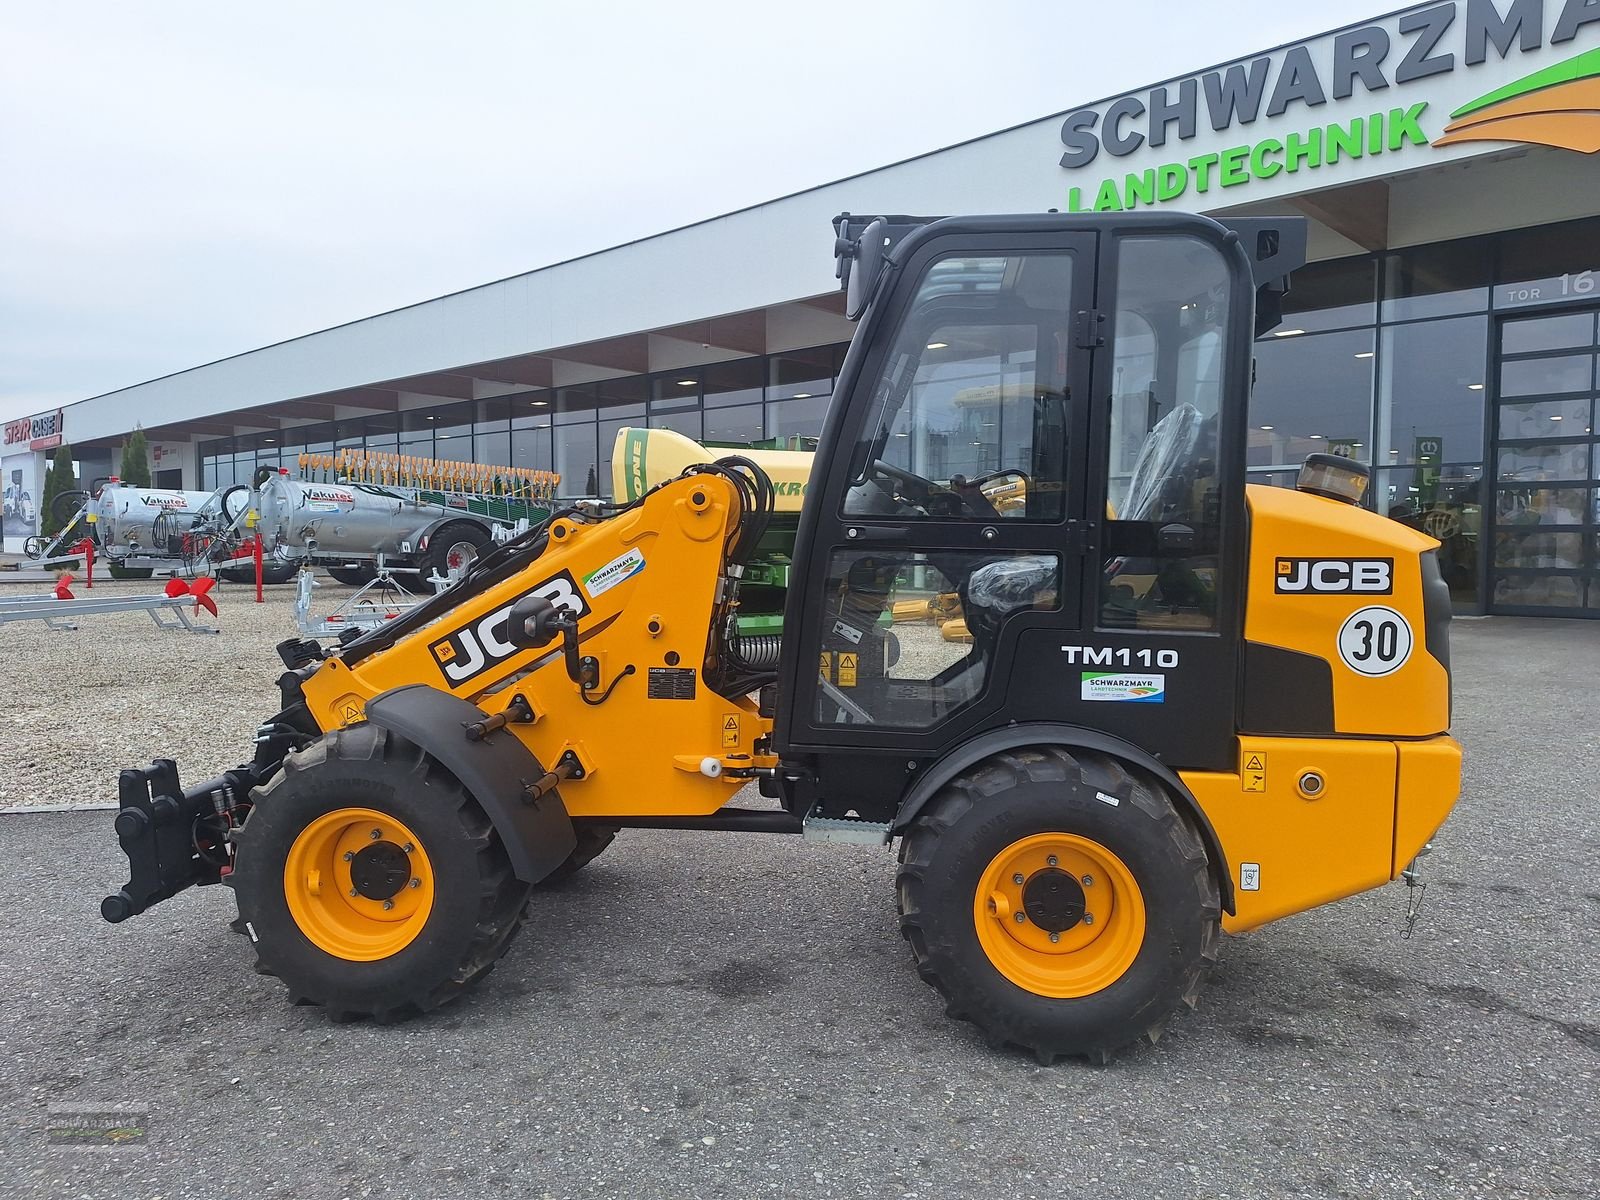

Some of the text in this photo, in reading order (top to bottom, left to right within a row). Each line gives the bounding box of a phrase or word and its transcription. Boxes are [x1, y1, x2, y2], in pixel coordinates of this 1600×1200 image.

[1069, 101, 1428, 212] LANDTECHNIK
[1508, 269, 1595, 301] TOR 16
[4, 418, 31, 445] STEYR
[633, 440, 643, 499] ONE
[141, 496, 186, 506] Vakutec
[302, 489, 353, 500] Vakutec
[590, 556, 634, 584] SCHWARZMAYR
[1278, 561, 1390, 591] JCB
[444, 578, 583, 680] JCB
[1352, 620, 1397, 661] 30
[1061, 646, 1178, 668] TM110
[1090, 679, 1153, 687] SCHWARZMAYR
